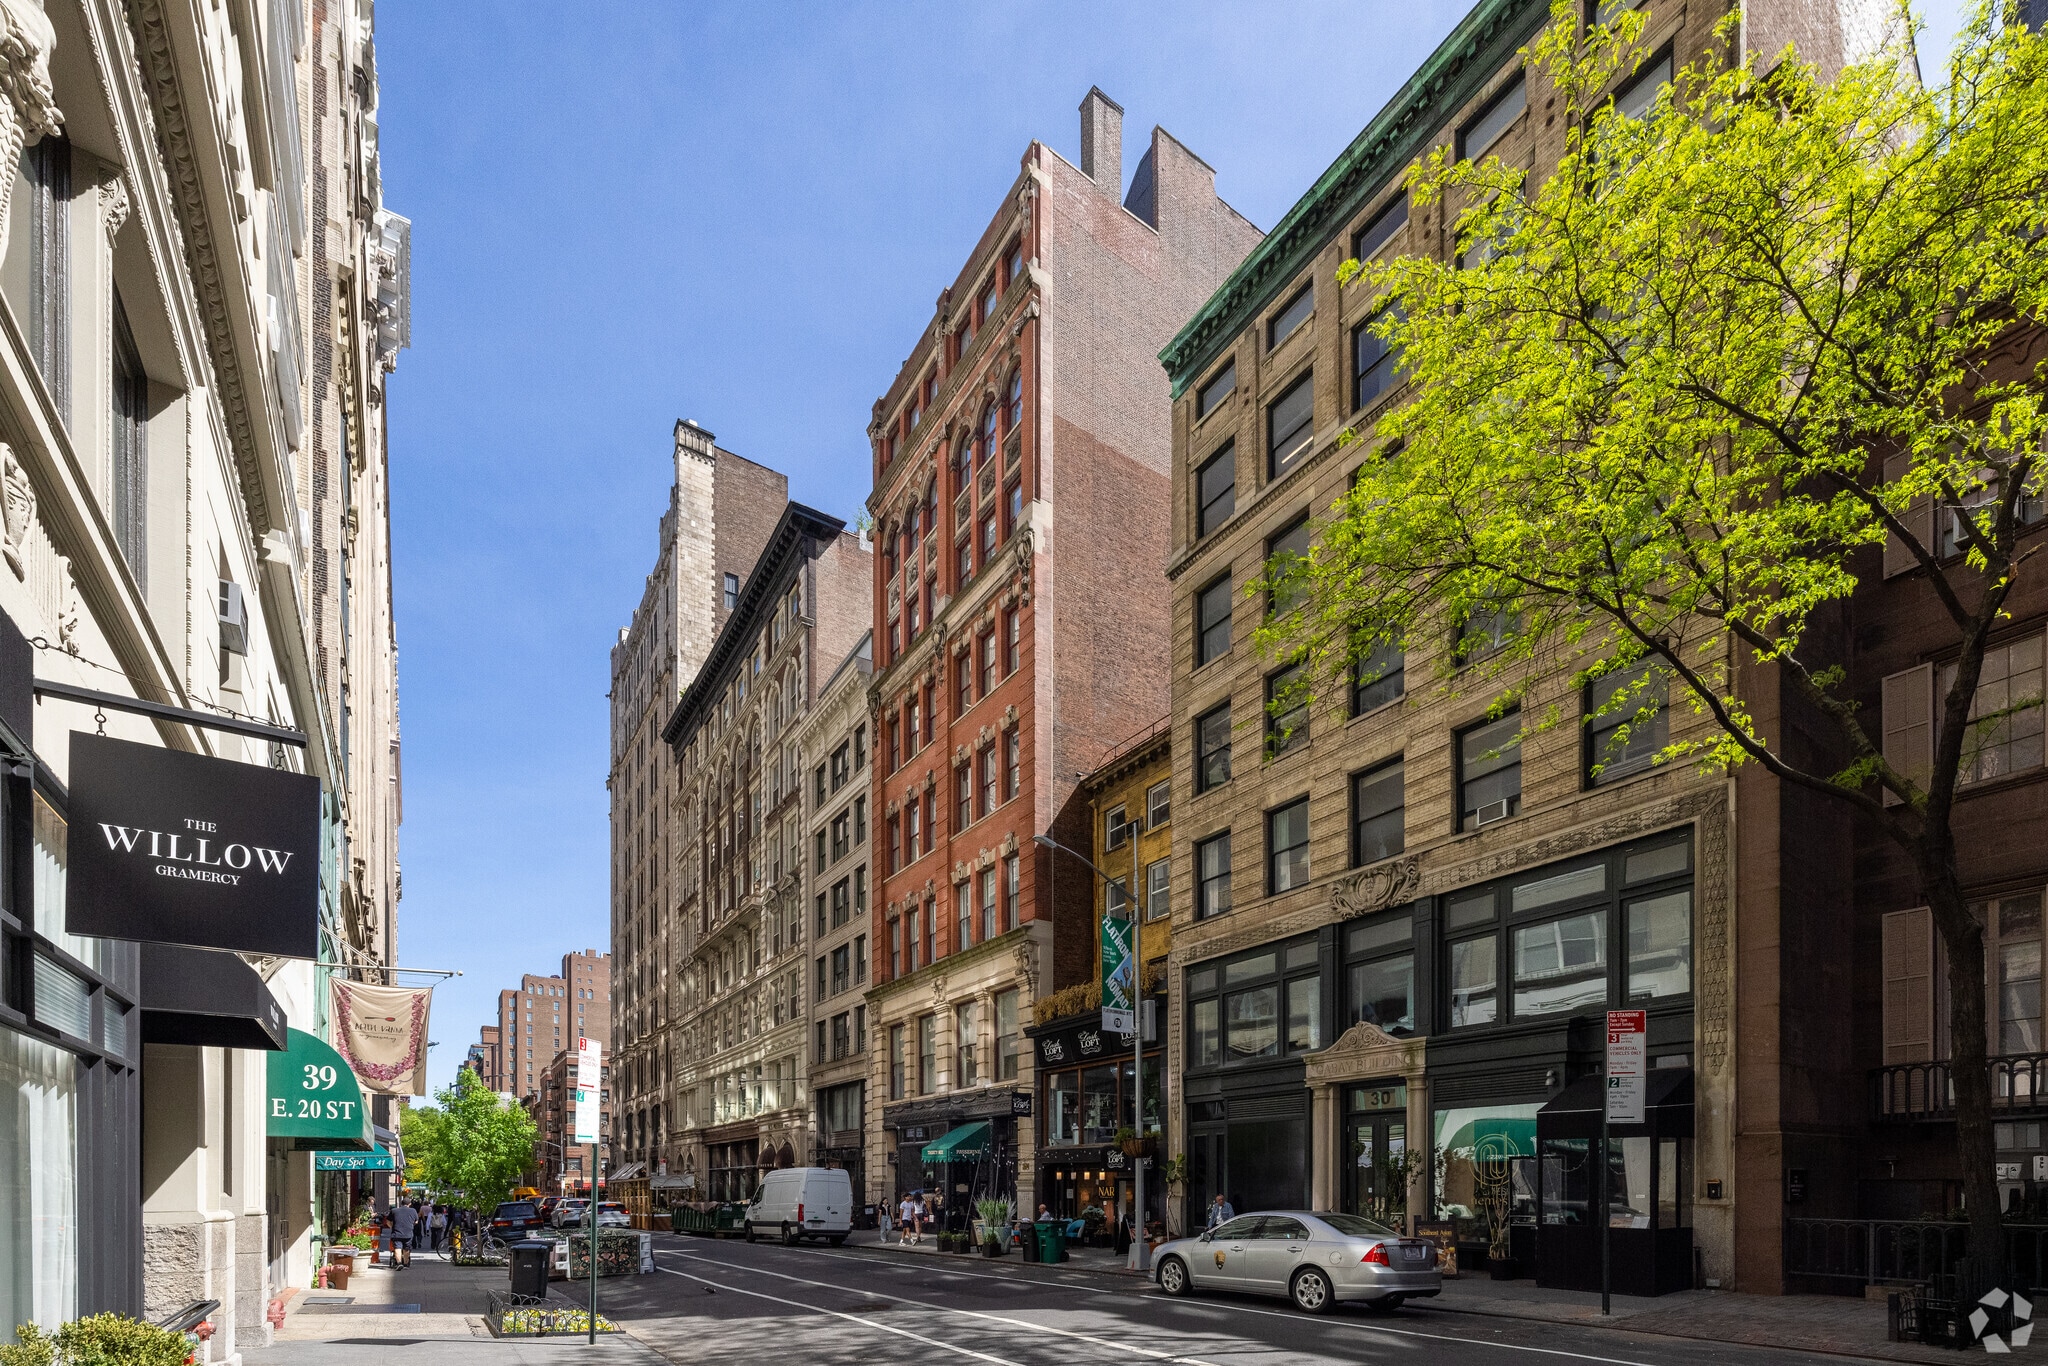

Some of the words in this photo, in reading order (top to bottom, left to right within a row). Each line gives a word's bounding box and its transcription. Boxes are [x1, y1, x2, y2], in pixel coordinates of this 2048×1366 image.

[184, 818, 217, 833] THE
[97, 822, 295, 875] WILLOW
[155, 864, 241, 886] GRAMERCY
[1102, 915, 1132, 959] FLATIRON
[1105, 978, 1130, 1010] NOMAD
[1611, 1033, 1617, 1042] 3
[1316, 1063, 1354, 1075] GABAY
[1356, 1054, 1411, 1071] BUILDING
[302, 1064, 337, 1091] 39
[1611, 1078, 1618, 1087] 2
[271, 1098, 293, 1118] E.
[297, 1099, 321, 1119] 20
[326, 1100, 356, 1120] ST
[1370, 1091, 1391, 1106] 30
[324, 1157, 345, 1168] Day
[347, 1157, 365, 1168] Spa
[1098, 1186, 1115, 1197] NAR
